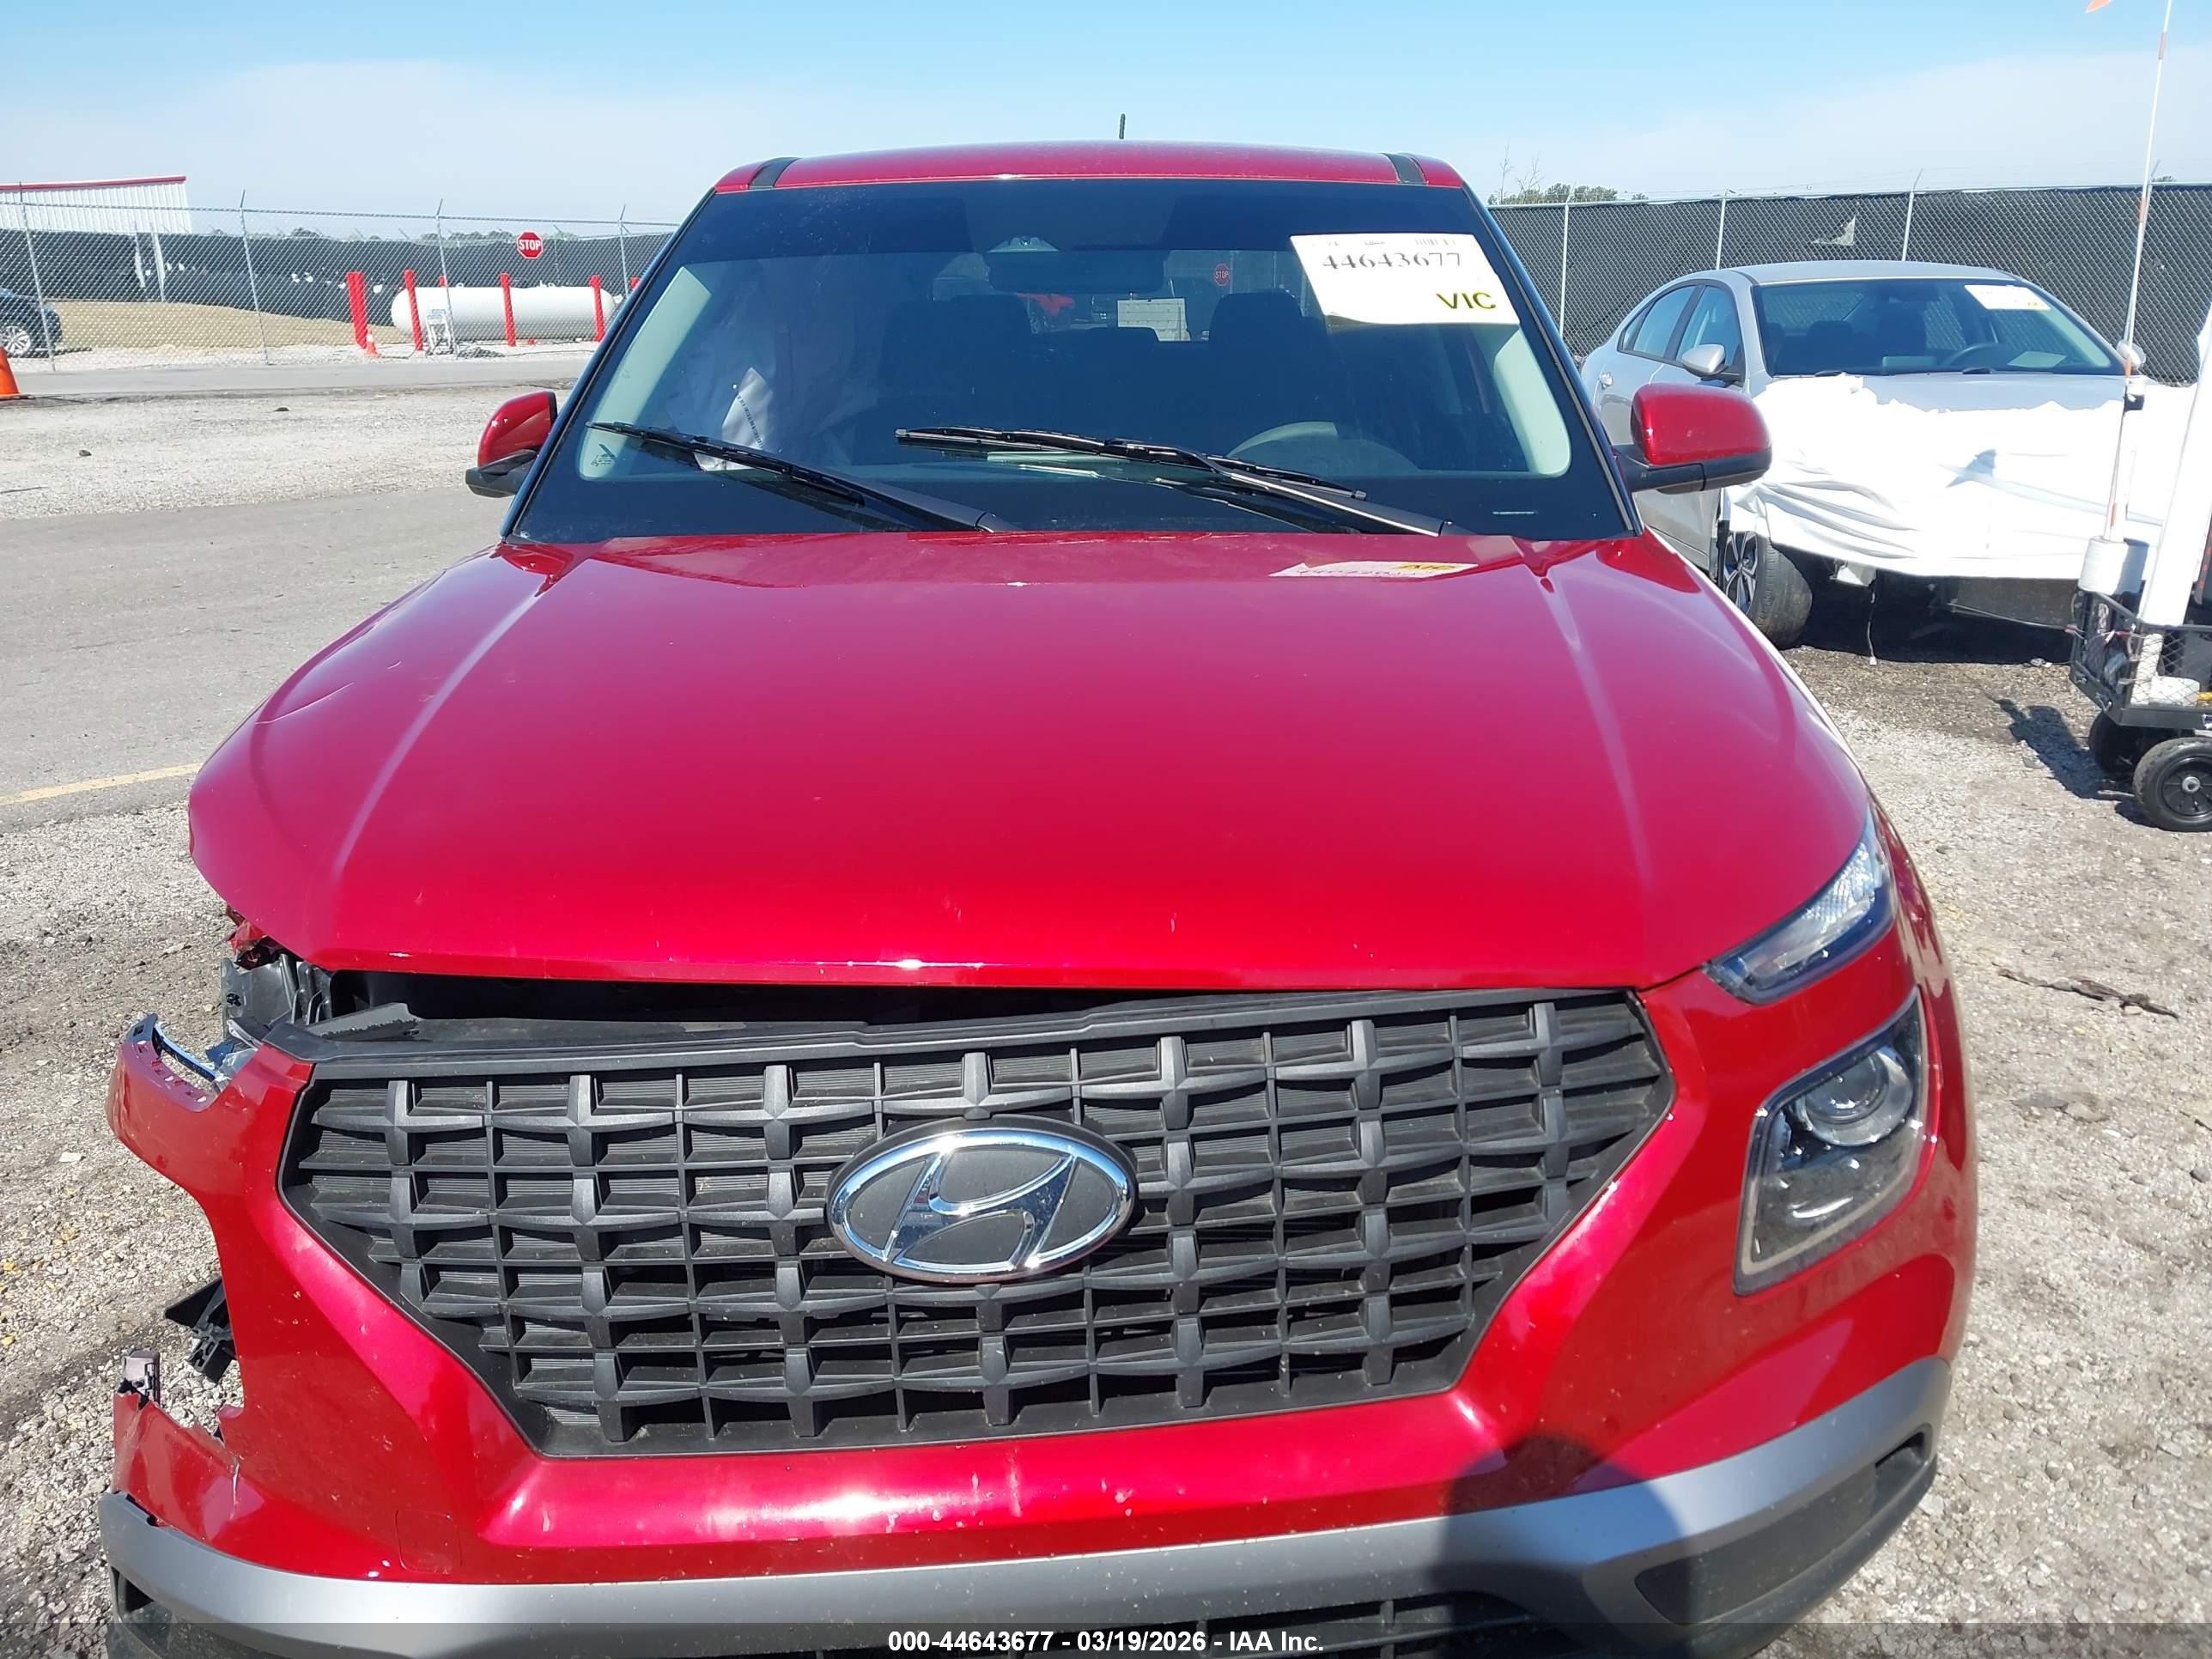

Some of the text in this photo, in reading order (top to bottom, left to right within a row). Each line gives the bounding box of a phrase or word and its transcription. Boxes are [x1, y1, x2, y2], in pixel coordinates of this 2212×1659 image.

[518, 240, 542, 251] STOP
[1322, 252, 1462, 270] 44643677
[1215, 270, 1229, 279] STOP
[1436, 292, 1497, 310] VIC
